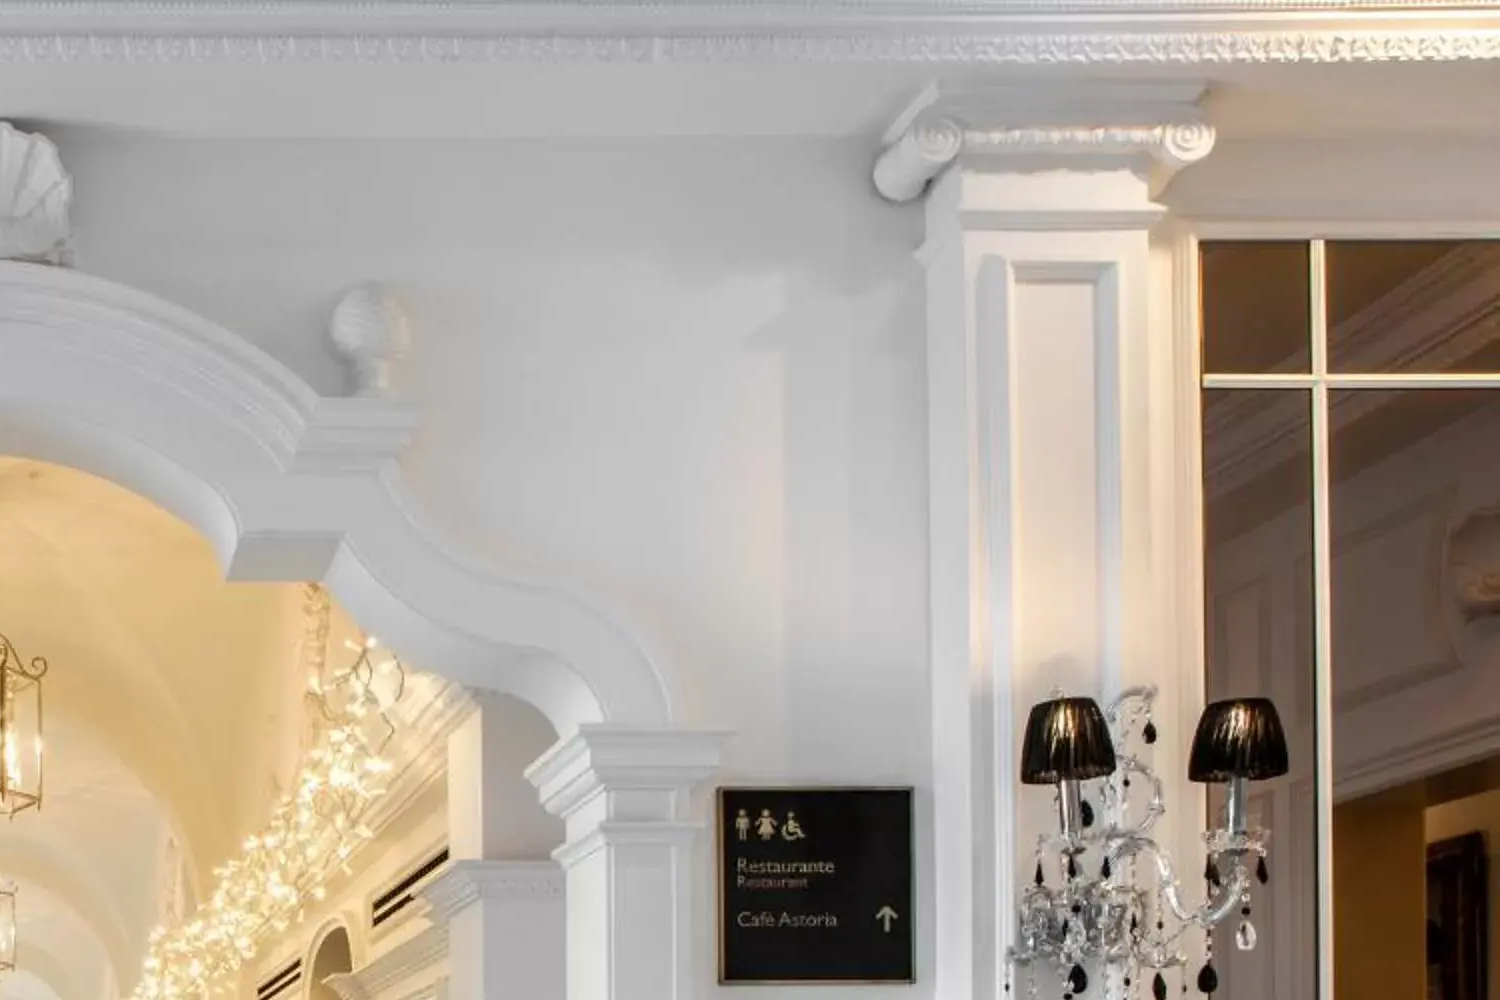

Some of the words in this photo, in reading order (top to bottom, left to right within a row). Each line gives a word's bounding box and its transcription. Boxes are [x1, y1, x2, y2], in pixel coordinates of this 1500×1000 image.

[737, 857, 835, 873] Restaurante
[737, 875, 808, 889] Restaurant
[779, 911, 837, 927] Astoria
